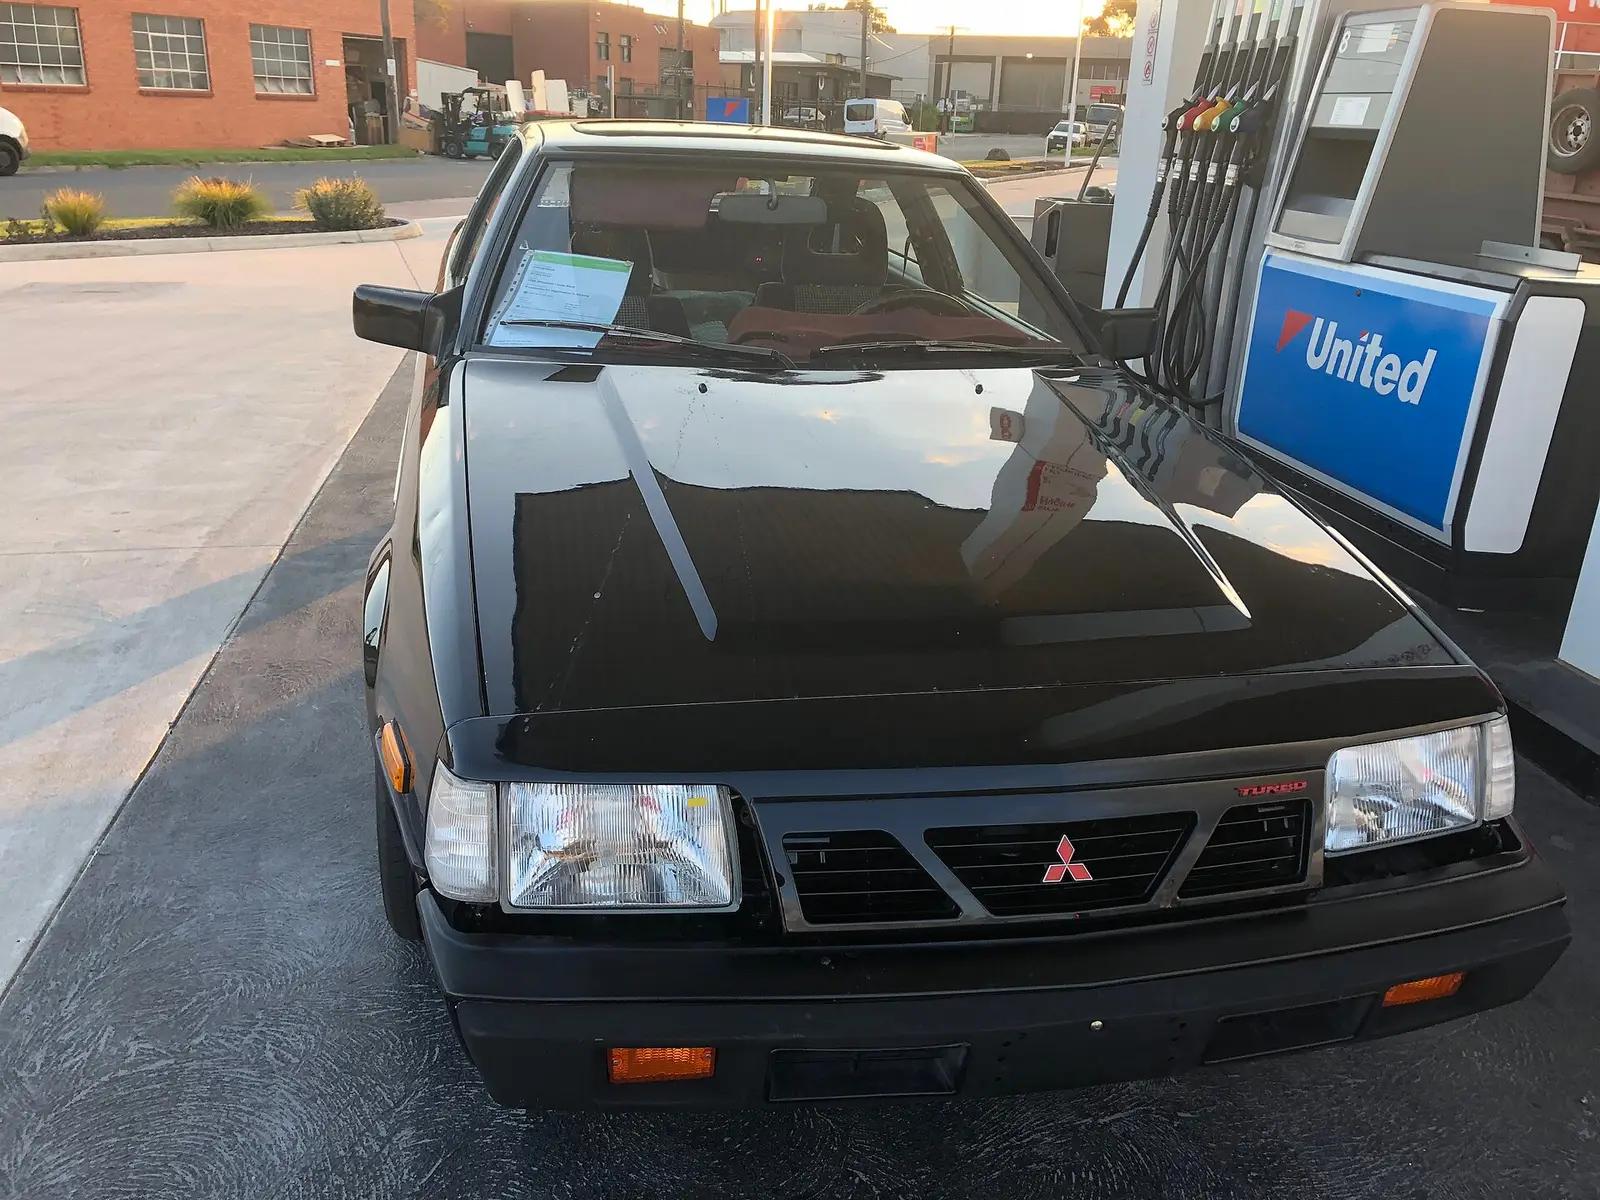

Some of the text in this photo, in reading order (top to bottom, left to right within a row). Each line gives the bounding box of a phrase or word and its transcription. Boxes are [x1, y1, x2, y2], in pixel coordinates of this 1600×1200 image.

[1339, 30, 1351, 53] 8
[1306, 316, 1438, 405] United
[1235, 780, 1307, 796] TURBO
